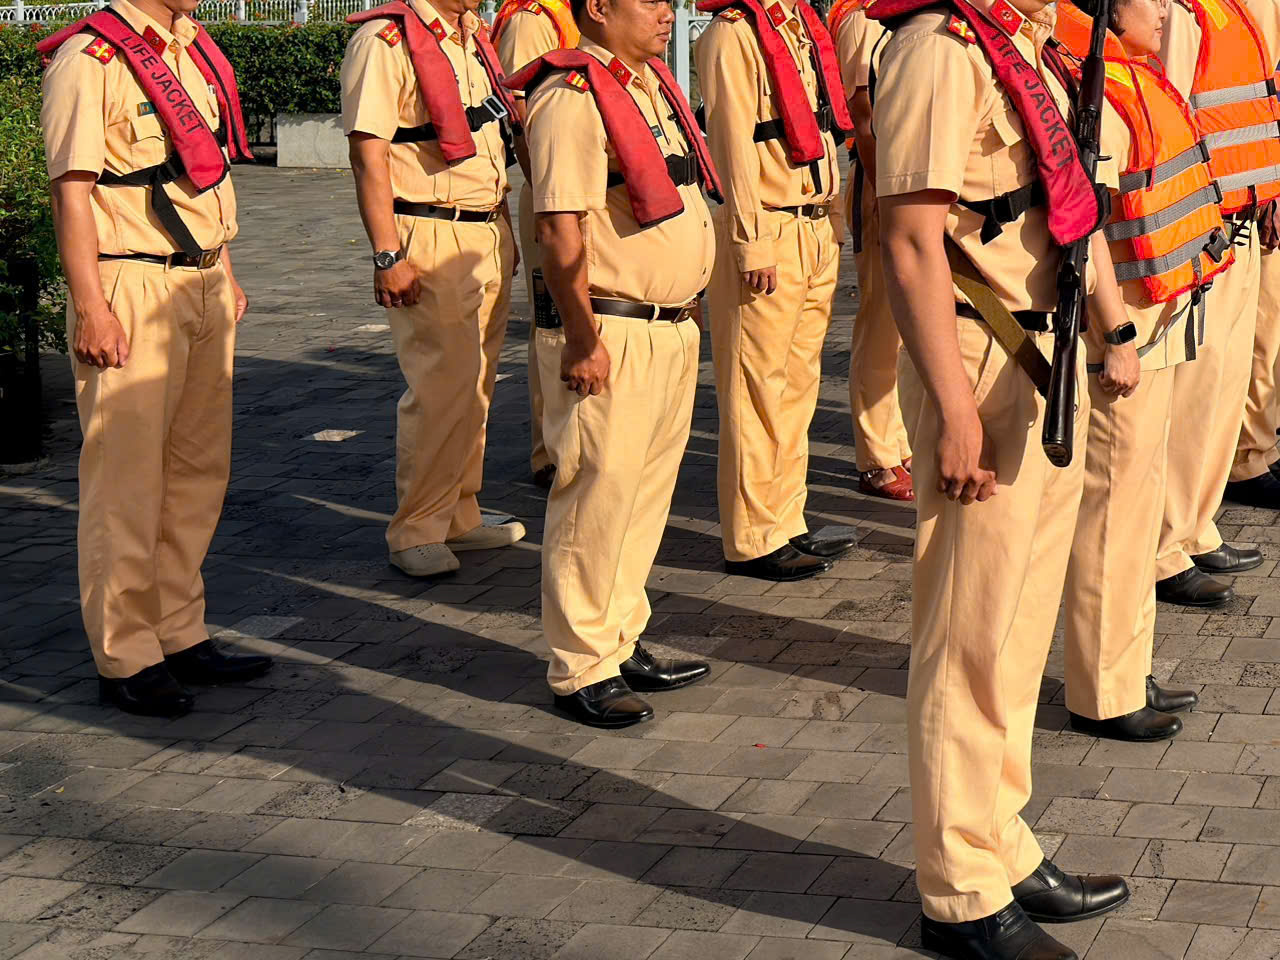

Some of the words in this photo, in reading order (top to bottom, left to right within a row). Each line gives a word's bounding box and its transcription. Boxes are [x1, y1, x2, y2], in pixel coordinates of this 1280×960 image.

[121, 36, 158, 70] LIFE
[151, 72, 204, 134] JACKET
[1024, 80, 1075, 168] JACKET
